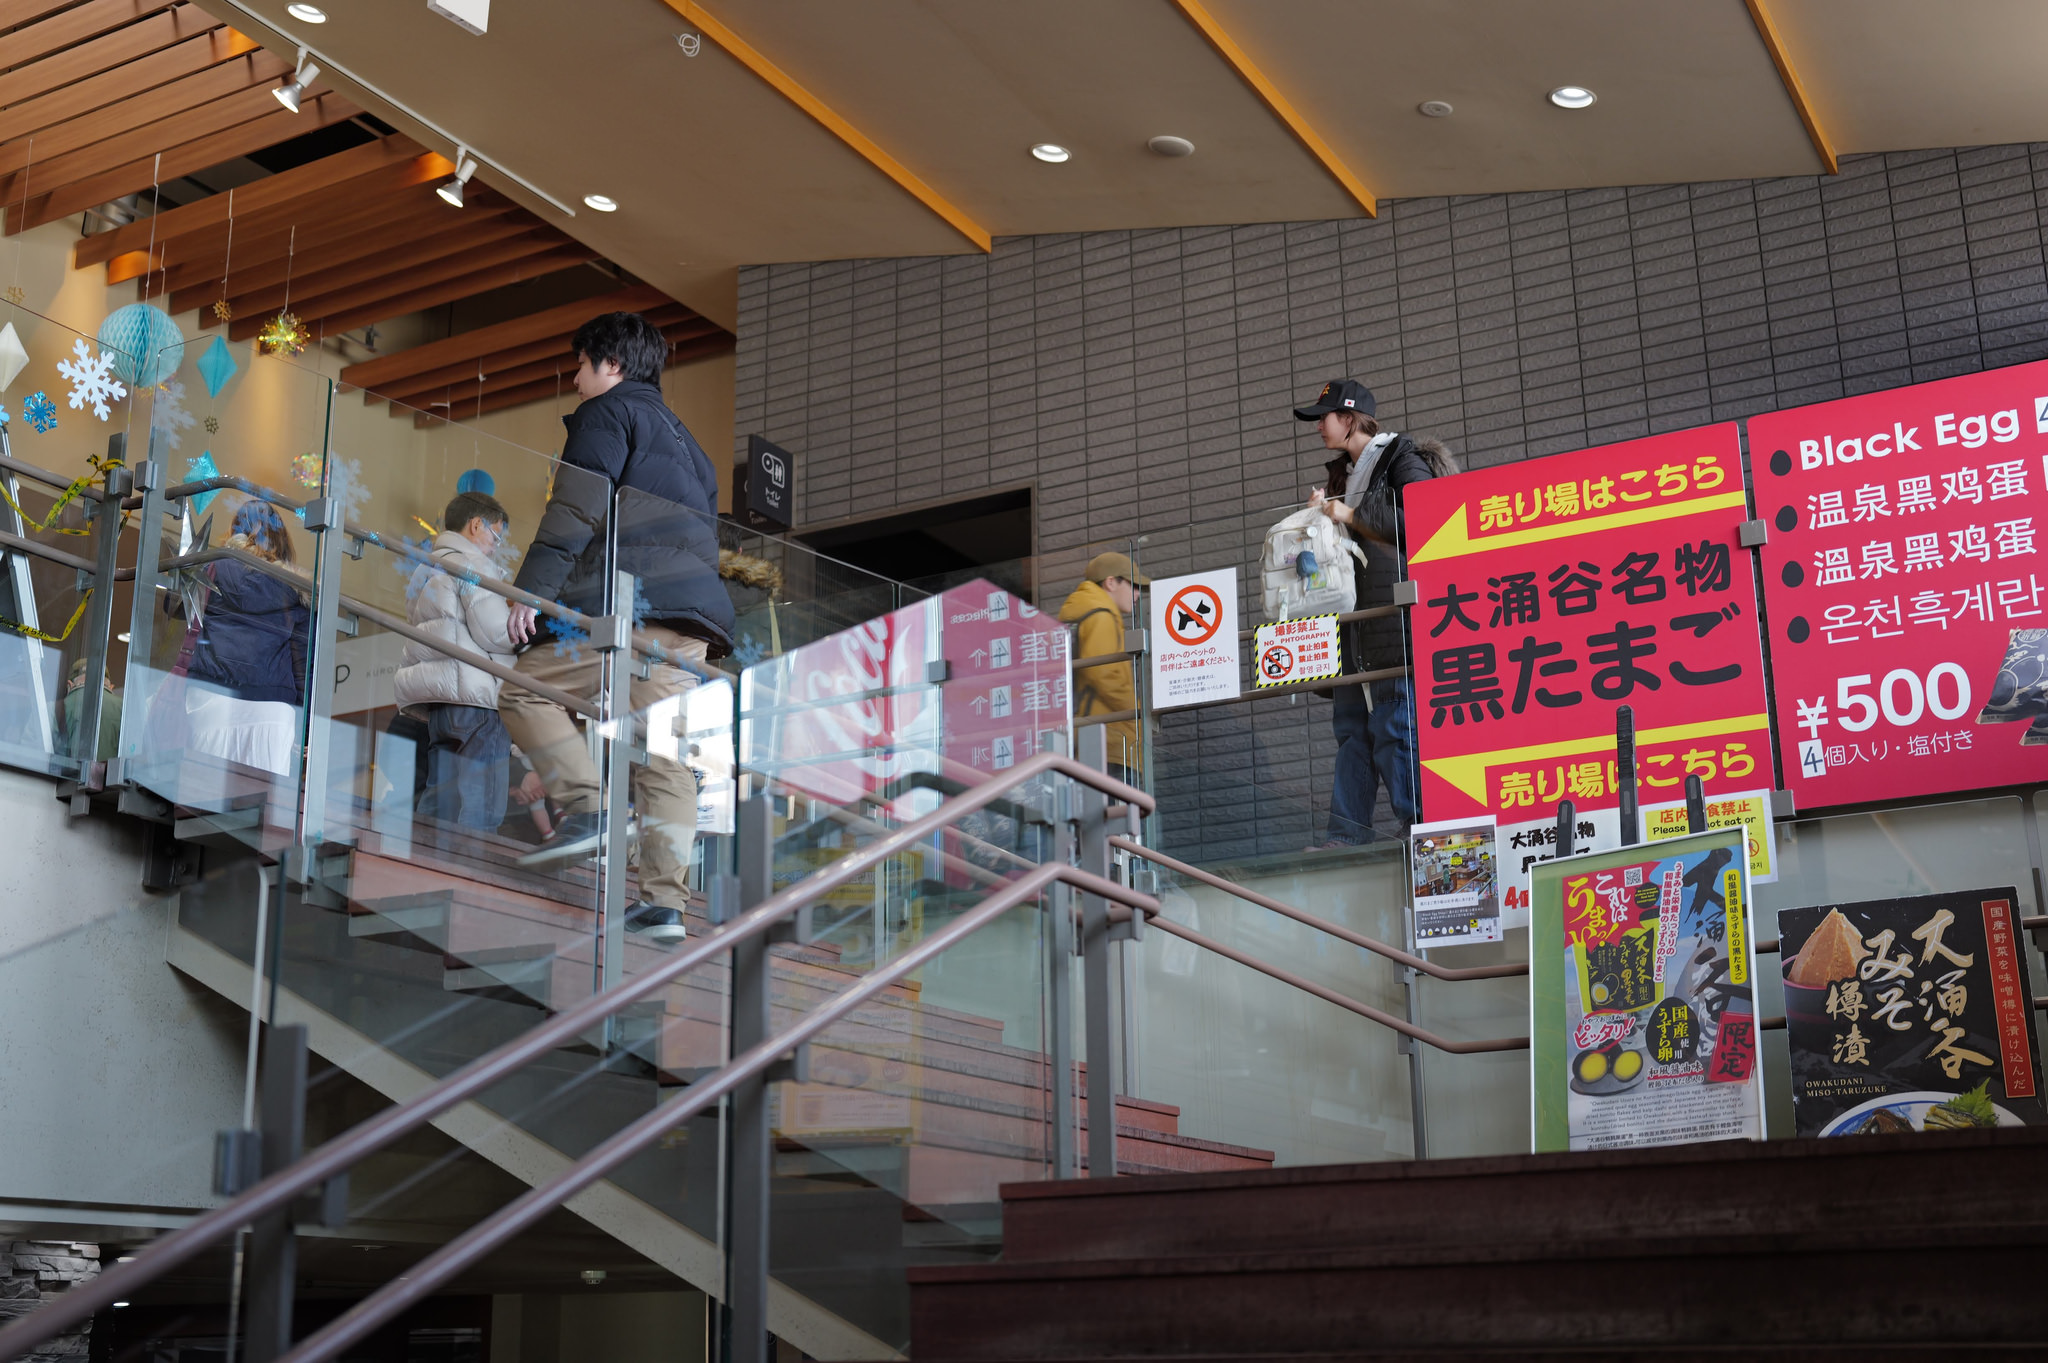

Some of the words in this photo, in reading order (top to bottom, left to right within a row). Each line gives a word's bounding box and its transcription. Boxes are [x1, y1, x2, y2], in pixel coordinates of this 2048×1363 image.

[1800, 422, 1922, 470] Black
[1935, 409, 2020, 448] Egg
[1479, 456, 1725, 531] 売り場はこちら
[1806, 459, 2029, 530] 温泉黑鸡蛋
[1427, 540, 1731, 638] 大涌谷名物
[1820, 574, 2045, 644] 온천흑계란
[1160, 647, 1216, 662] 店内へのペットの
[1275, 620, 1319, 637] 撮影禁止
[1280, 632, 1330, 644] PHTOGRAPHY
[1160, 657, 1234, 673] 同伴はご遠慮ください。
[1429, 601, 1742, 728] 黒たまご
[1796, 662, 1972, 739] ¥500
[1802, 730, 1973, 773] 4個入り・塩付き
[1510, 821, 1596, 849] 大涌谷物
[1653, 823, 1686, 835] Please
[1724, 817, 1741, 827] eat
[1744, 816, 1756, 824] or
[1660, 800, 1752, 824] 店内食禁止
[1596, 874, 1631, 924] これは
[1666, 862, 1684, 956] うまみと栄養たっぷりの
[1861, 929, 1914, 1031] みそ
[1911, 909, 1994, 1079] 大涌谷
[1717, 1022, 1754, 1078] 限定
[1826, 981, 1872, 1066] 樽漬
[1806, 1077, 1864, 1088] OWAKUDANI
[1806, 1085, 1888, 1098] MISO-TARUZUKE
